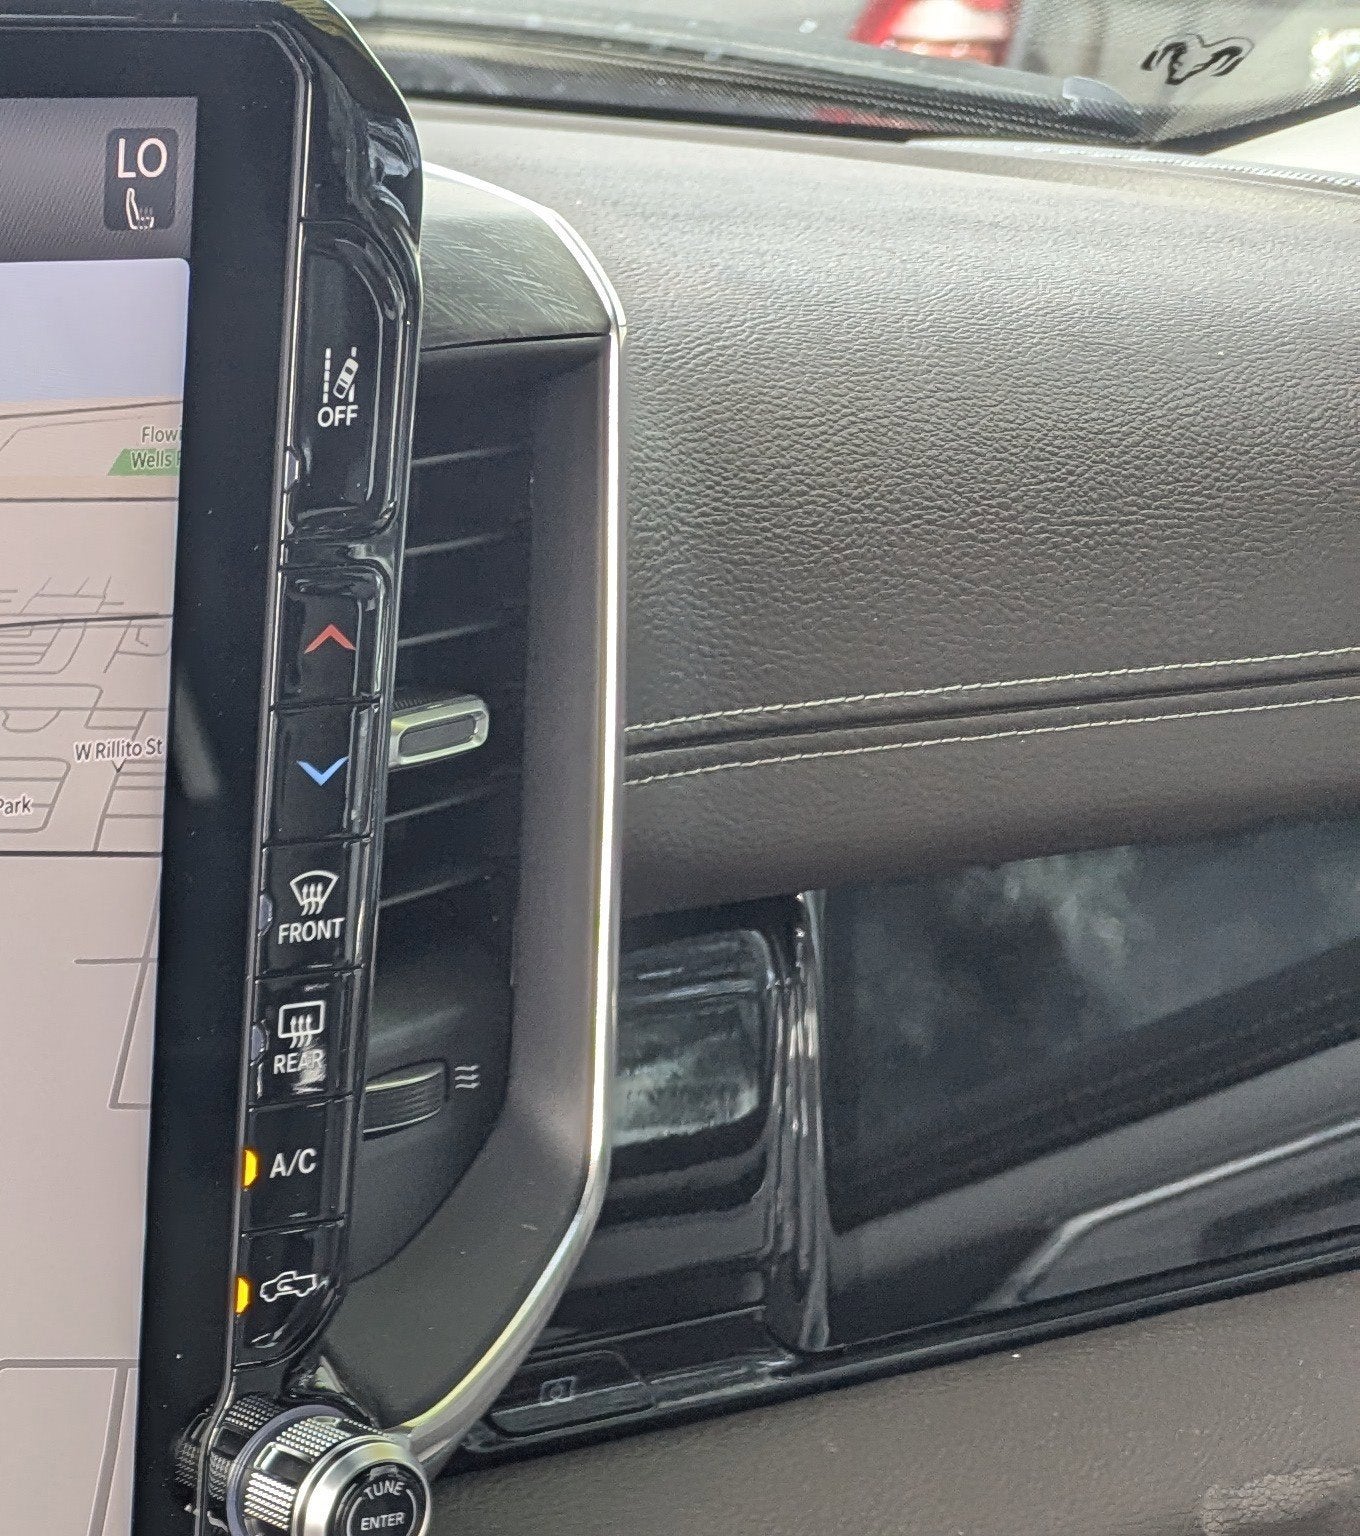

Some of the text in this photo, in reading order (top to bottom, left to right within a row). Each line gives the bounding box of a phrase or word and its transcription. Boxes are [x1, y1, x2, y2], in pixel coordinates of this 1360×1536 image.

[116, 136, 169, 181] LO
[317, 404, 359, 428] OFF
[131, 450, 172, 469] Wells
[74, 737, 163, 761] W Rillito St
[277, 917, 345, 945] FRONT
[273, 1049, 325, 1075] REAR
[269, 1147, 318, 1179] A/C
[362, 1480, 406, 1501] TUNE
[360, 1511, 406, 1532] ENTER
